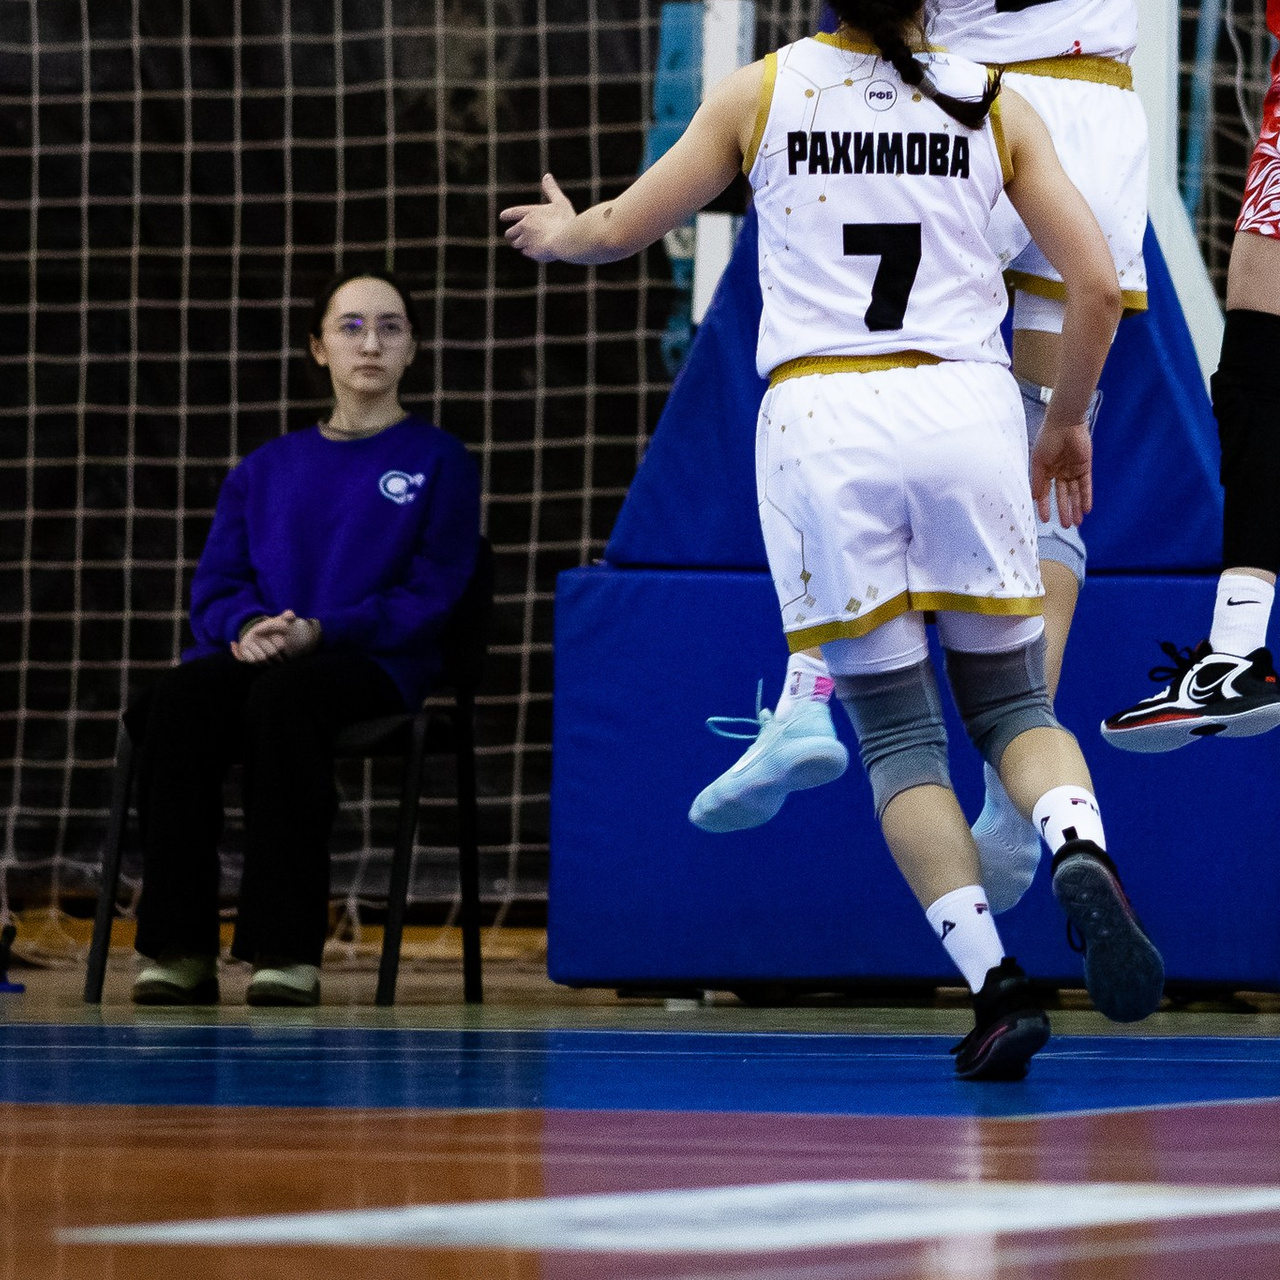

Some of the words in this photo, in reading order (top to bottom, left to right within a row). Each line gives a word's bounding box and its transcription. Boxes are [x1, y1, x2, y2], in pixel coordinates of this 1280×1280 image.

[868, 91, 893, 100] РФБ
[787, 131, 970, 180] РАХИМОВА
[842, 222, 923, 332] 7
